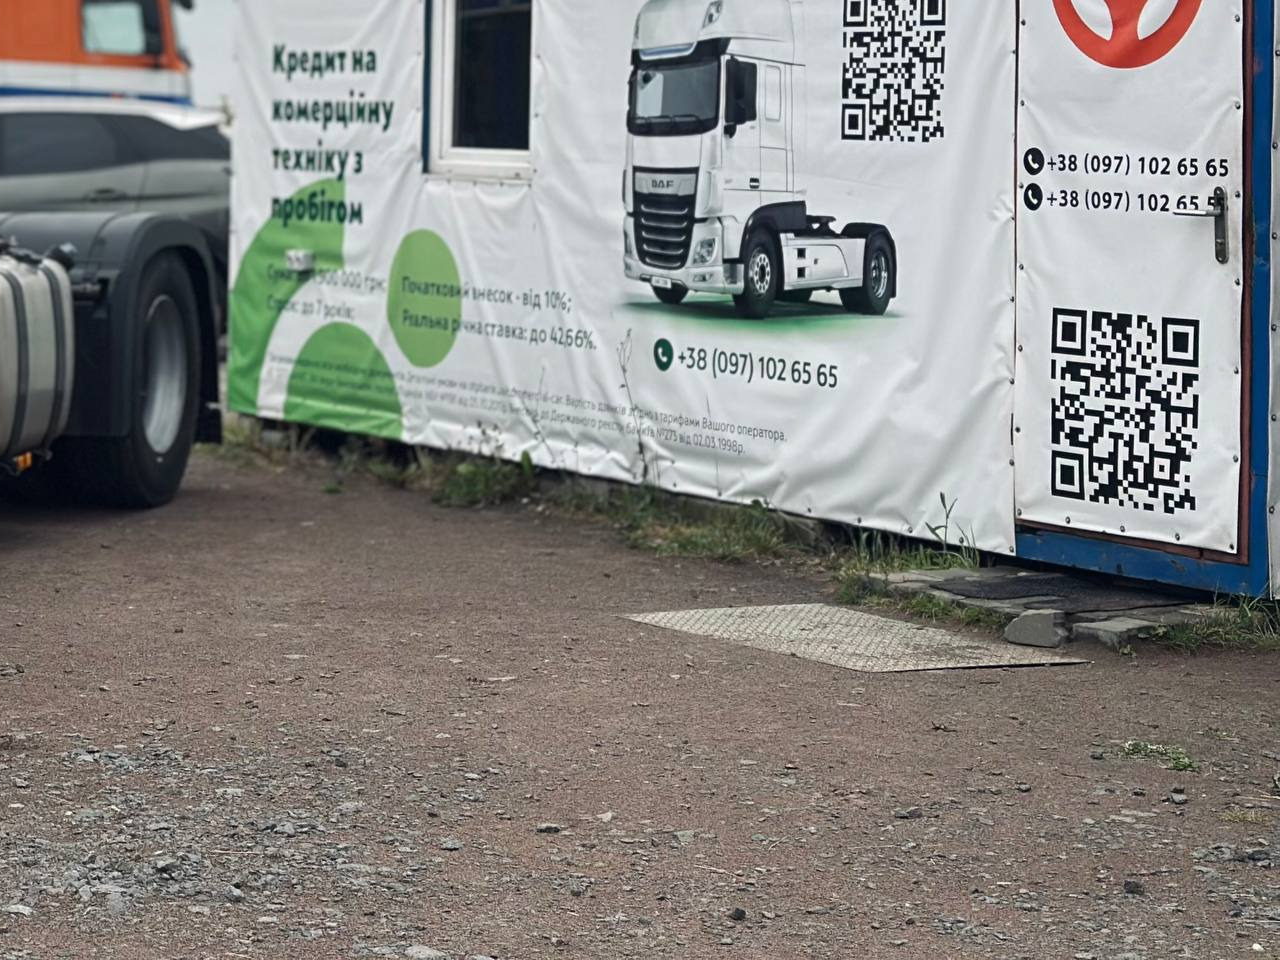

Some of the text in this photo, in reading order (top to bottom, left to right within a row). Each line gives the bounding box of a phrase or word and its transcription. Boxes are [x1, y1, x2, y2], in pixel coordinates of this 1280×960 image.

[272, 44, 376, 79] Кредит на
[272, 89, 394, 132] комерційну
[272, 139, 363, 180] техніку з
[1047, 153, 1229, 177] +38 (097) 102 65 65
[651, 179, 674, 189] DAF
[1047, 190, 1079, 208] +38
[1085, 189, 1130, 212] (097)
[1138, 194, 1170, 212] 102
[1176, 196, 1199, 211] 65
[272, 189, 363, 228] пробігом
[402, 276, 469, 299] Початковий
[472, 286, 513, 304] внесок
[522, 288, 541, 309] від
[529, 327, 548, 344] до
[677, 347, 839, 388] +38 (097) 102 65 65
[660, 413, 700, 428] тарифами
[702, 417, 736, 434] Вашого
